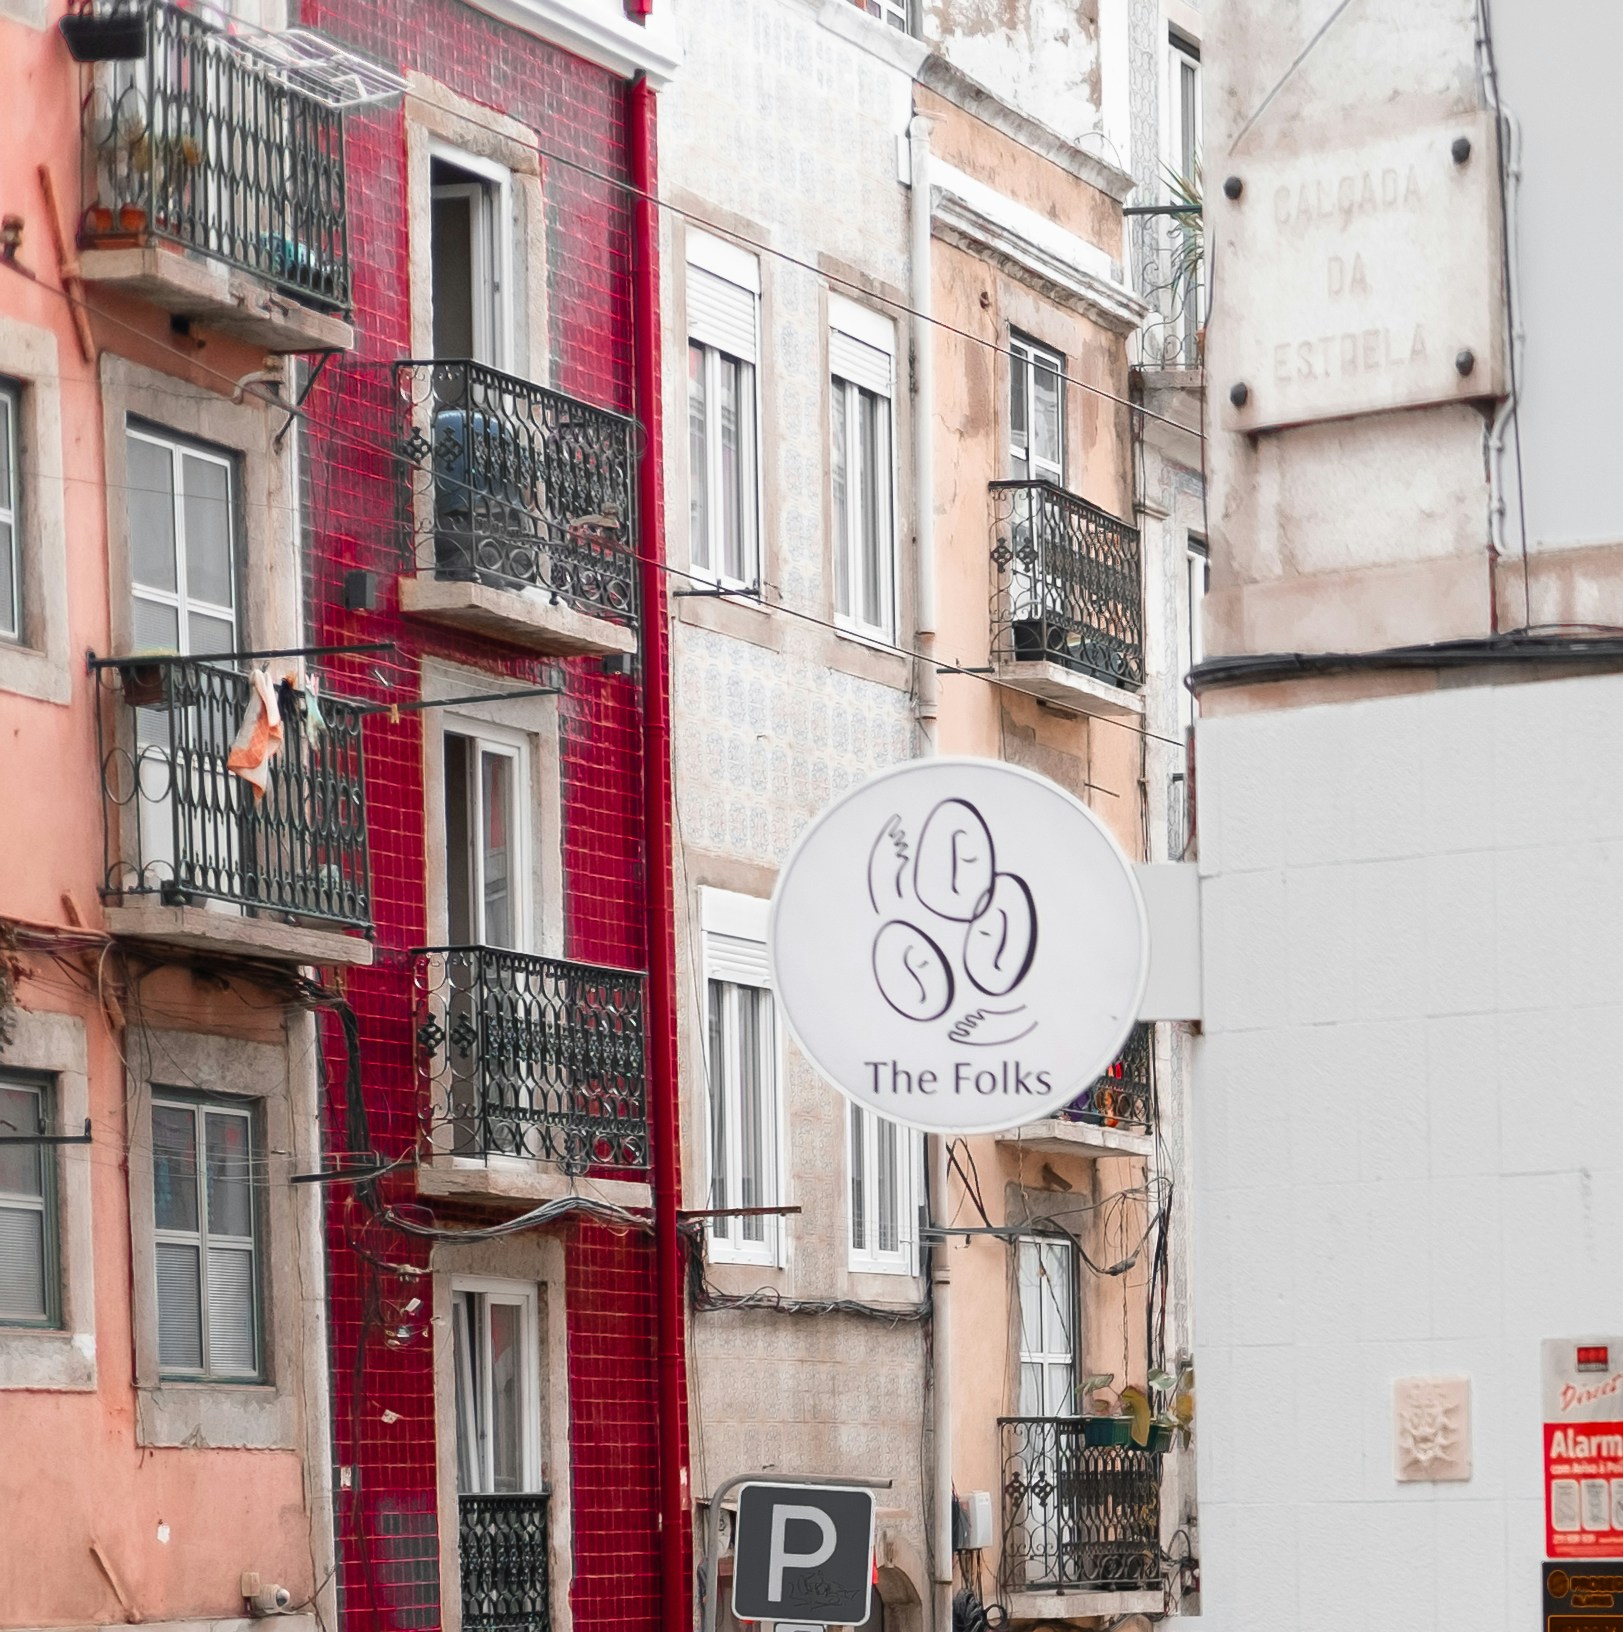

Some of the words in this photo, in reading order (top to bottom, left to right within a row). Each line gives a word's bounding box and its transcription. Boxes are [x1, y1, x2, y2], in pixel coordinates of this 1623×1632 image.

[1327, 251, 1371, 297] DA
[864, 1060, 938, 1096] The
[954, 1060, 1052, 1096] Folks
[768, 1504, 838, 1602] P
